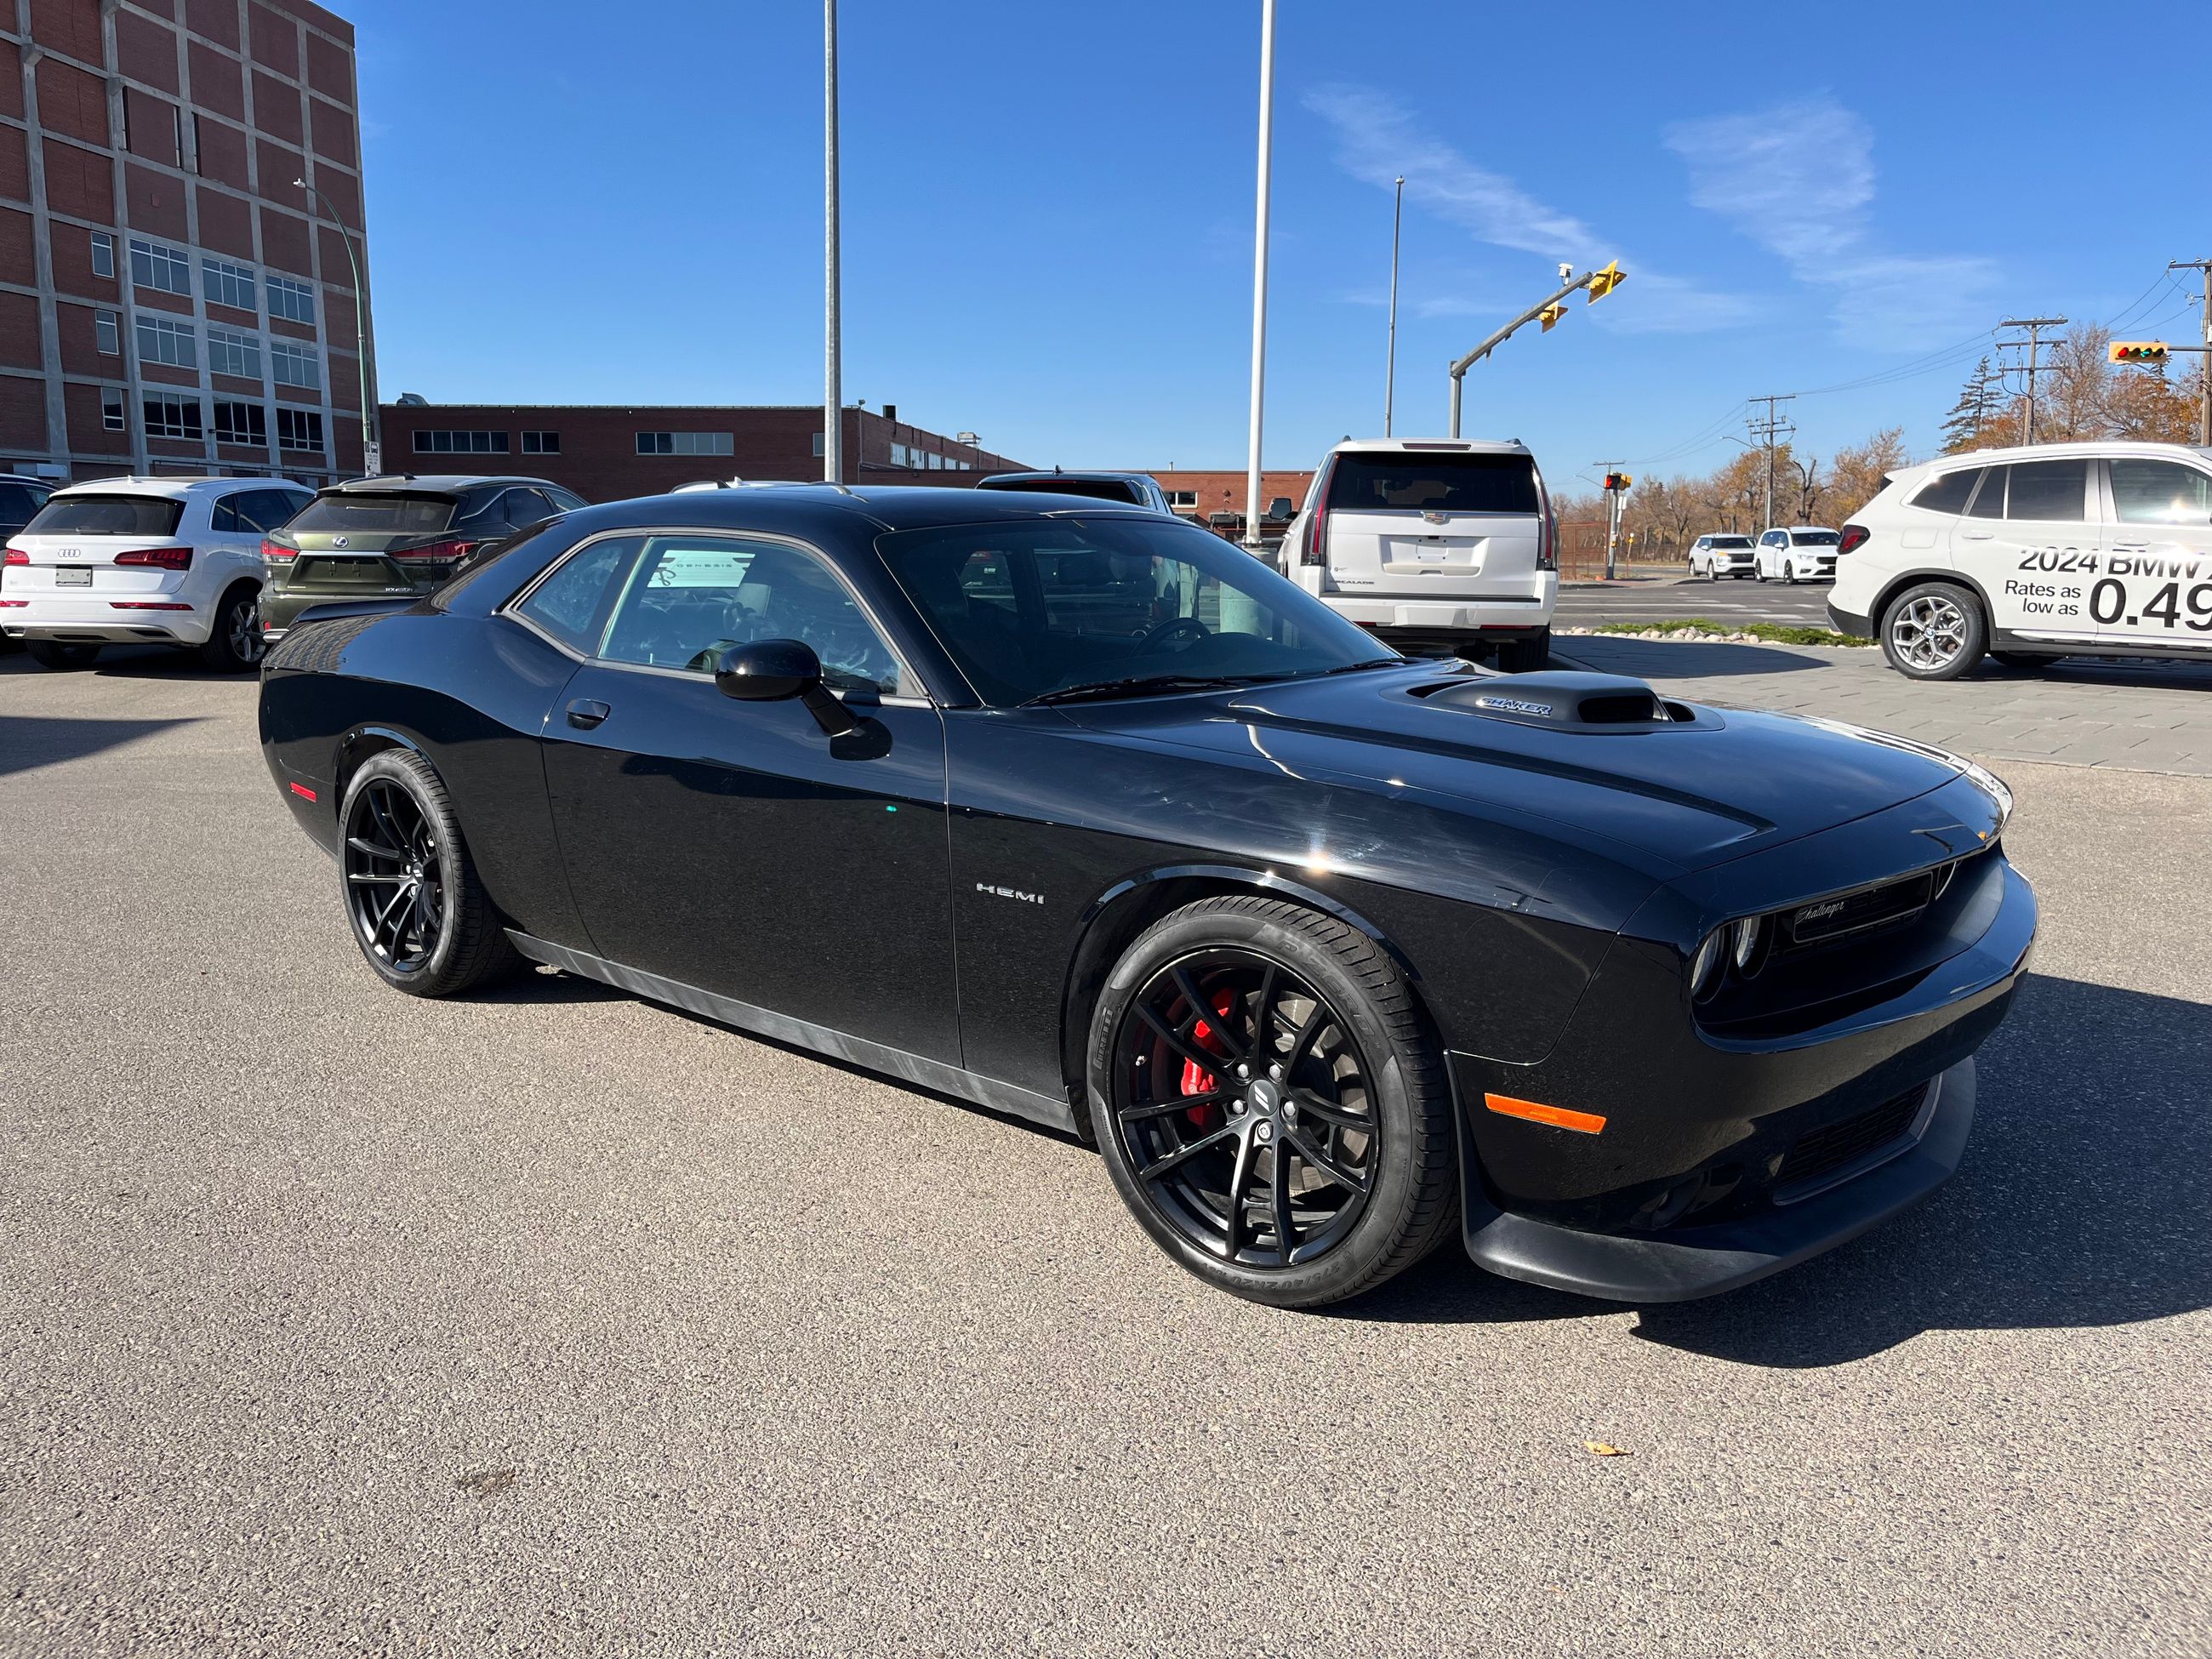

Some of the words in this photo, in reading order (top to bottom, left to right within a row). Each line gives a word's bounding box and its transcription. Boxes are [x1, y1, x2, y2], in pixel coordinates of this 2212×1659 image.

[2018, 545, 2099, 574] 2024
[2107, 549, 2205, 579] BMW
[2004, 579, 2055, 597] Rates
[2061, 585, 2081, 599] as
[2022, 598, 2054, 613] low
[2057, 603, 2079, 616] as
[2089, 578, 2212, 632] 0.49
[1479, 696, 1553, 715] SHAKER
[976, 882, 1045, 904] HEMI
[1797, 901, 1844, 924] Challenger
[1092, 1006, 1114, 1070] PIRELLI
